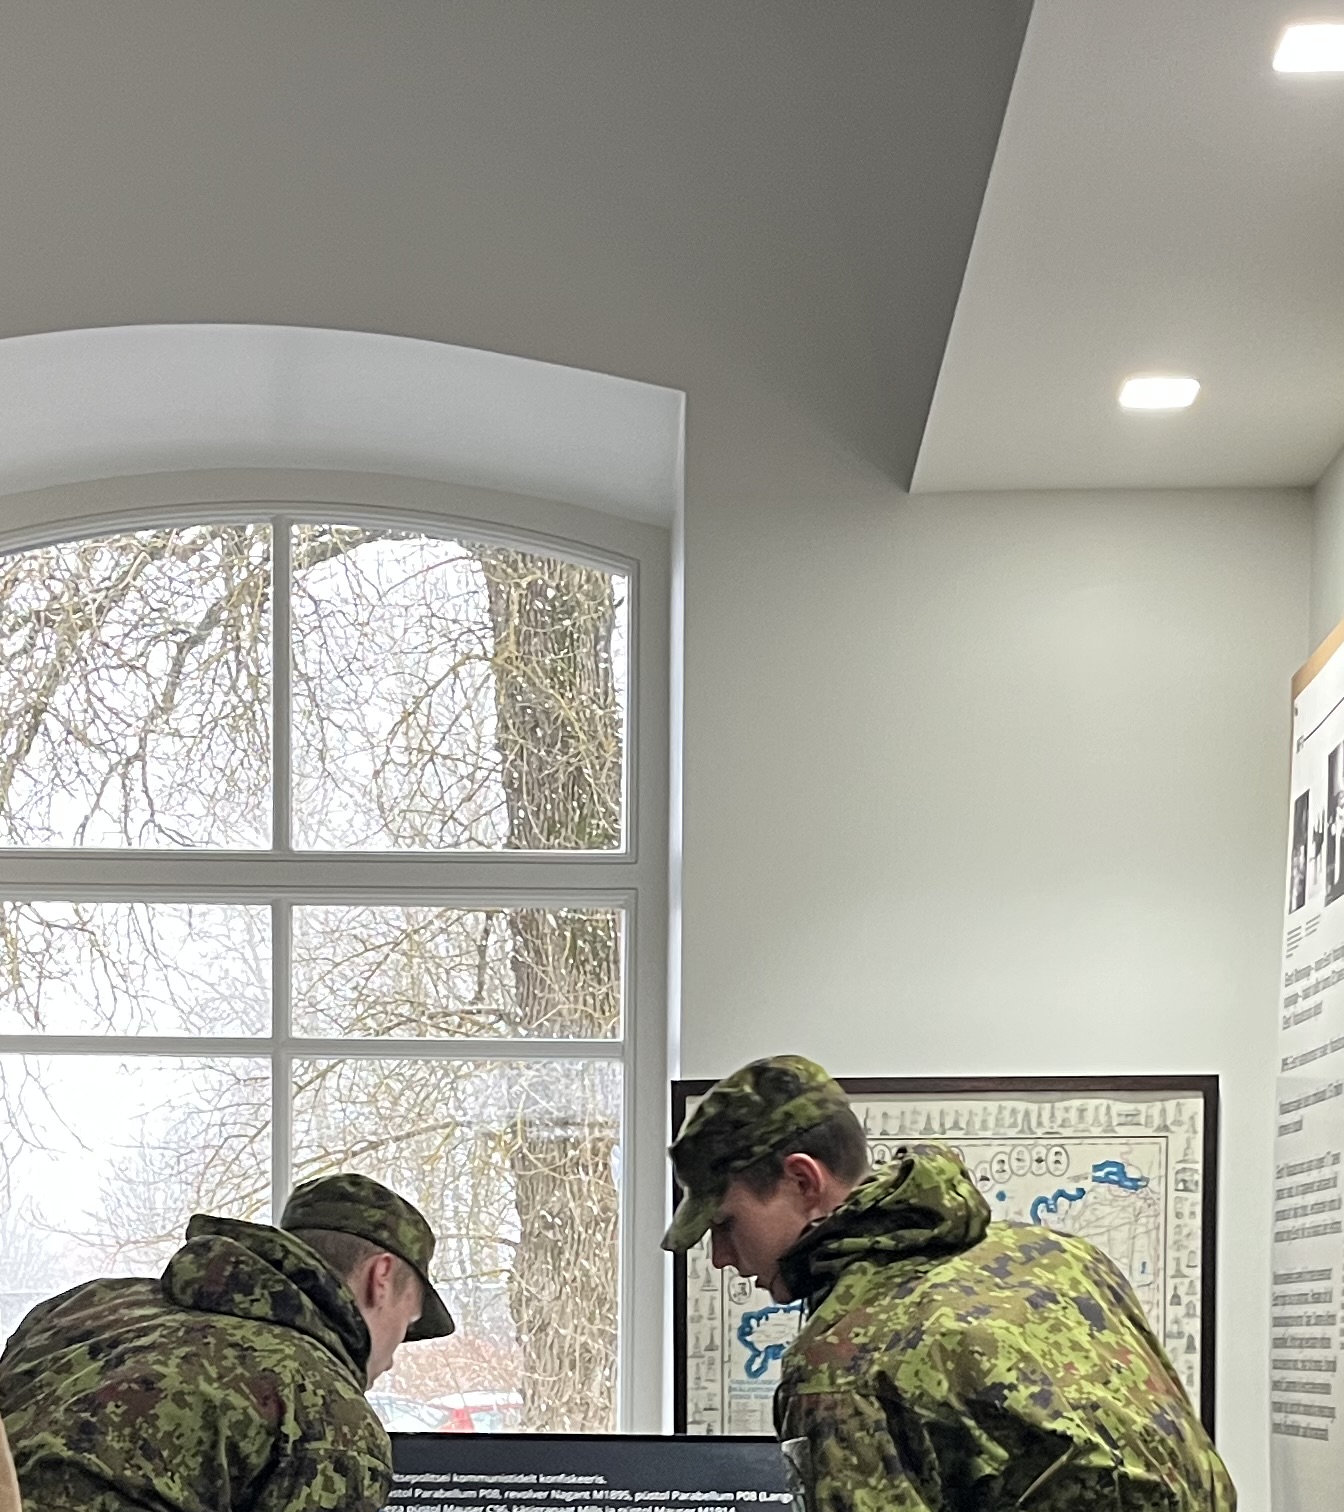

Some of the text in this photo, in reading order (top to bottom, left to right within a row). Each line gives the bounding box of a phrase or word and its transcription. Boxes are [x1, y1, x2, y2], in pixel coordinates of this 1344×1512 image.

[414, 1488, 477, 1499] Parabellum
[504, 1489, 549, 1499] revolver
[671, 1491, 734, 1501] Parabellum
[736, 1491, 757, 1501] P08
[759, 1491, 794, 1504] (Lang
